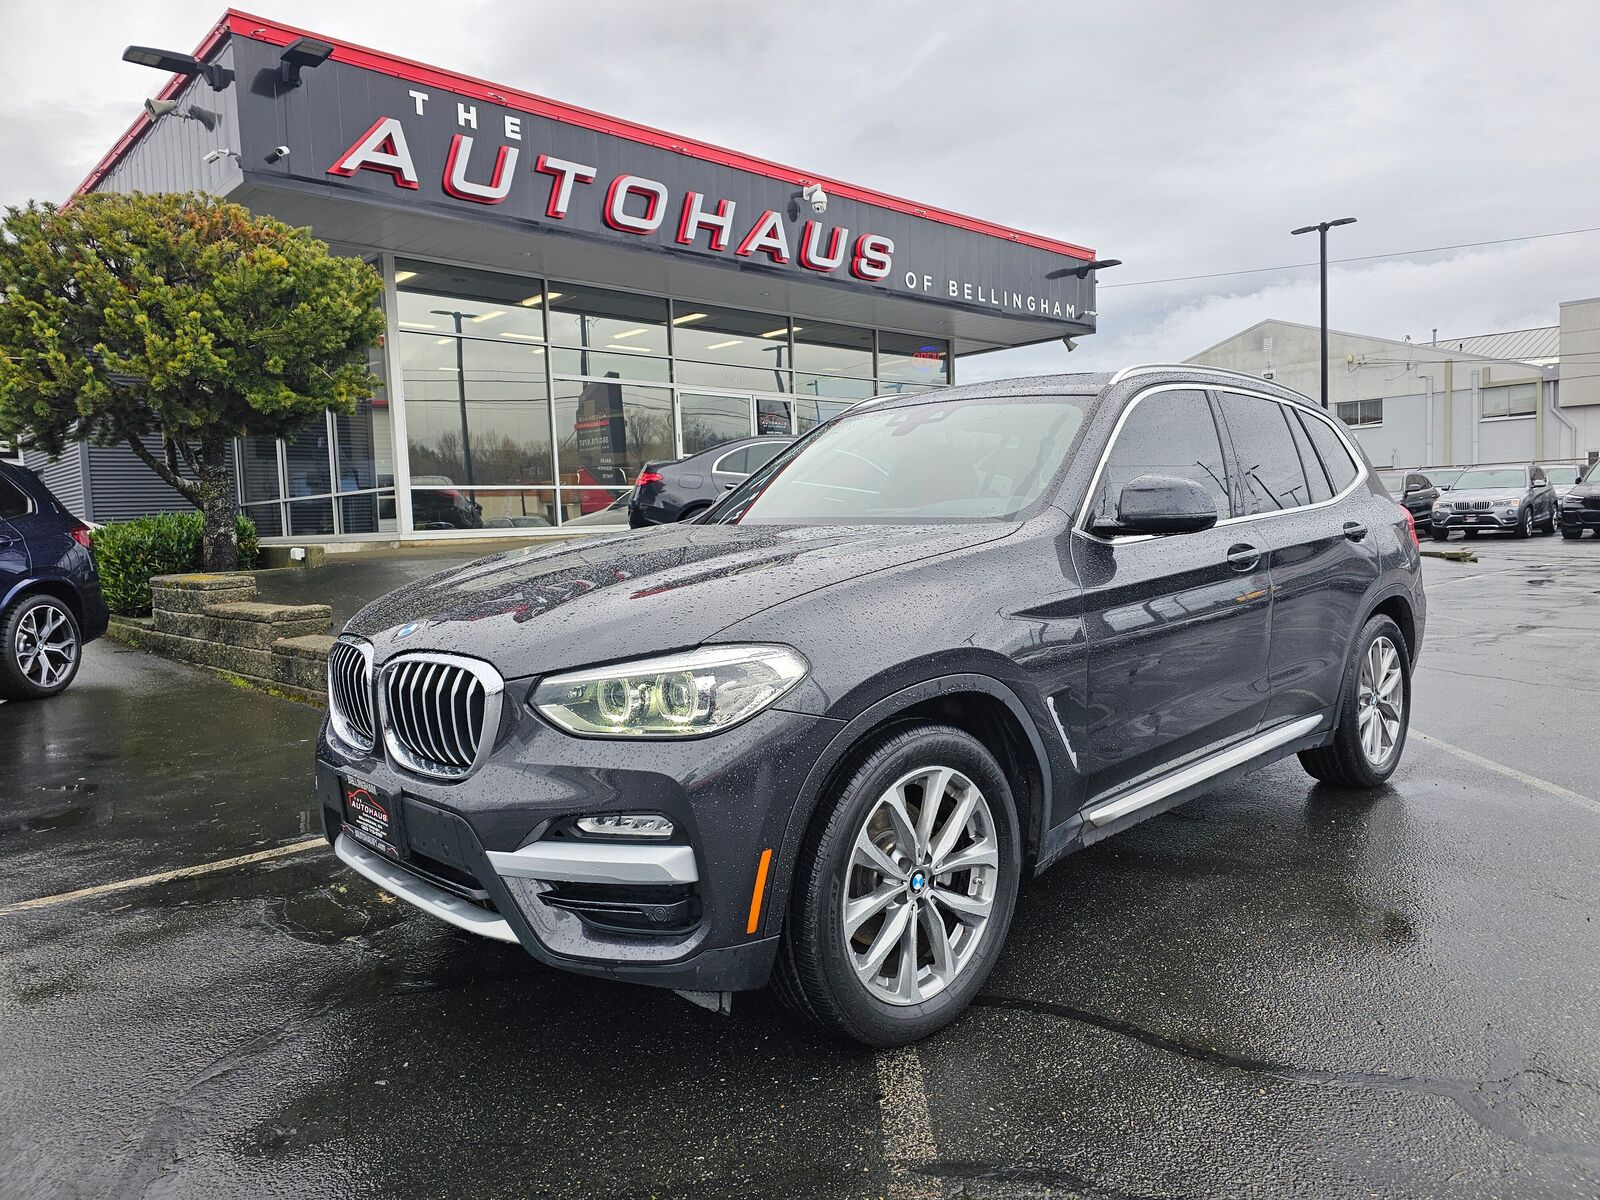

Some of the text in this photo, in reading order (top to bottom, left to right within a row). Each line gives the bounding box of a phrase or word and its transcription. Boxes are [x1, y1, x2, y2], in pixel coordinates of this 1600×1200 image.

[408, 89, 522, 140] THE
[327, 115, 896, 282] AUTOHAUS
[904, 271, 1076, 319] OF BELLINGHAM
[351, 800, 388, 822] AUTOHAUS
